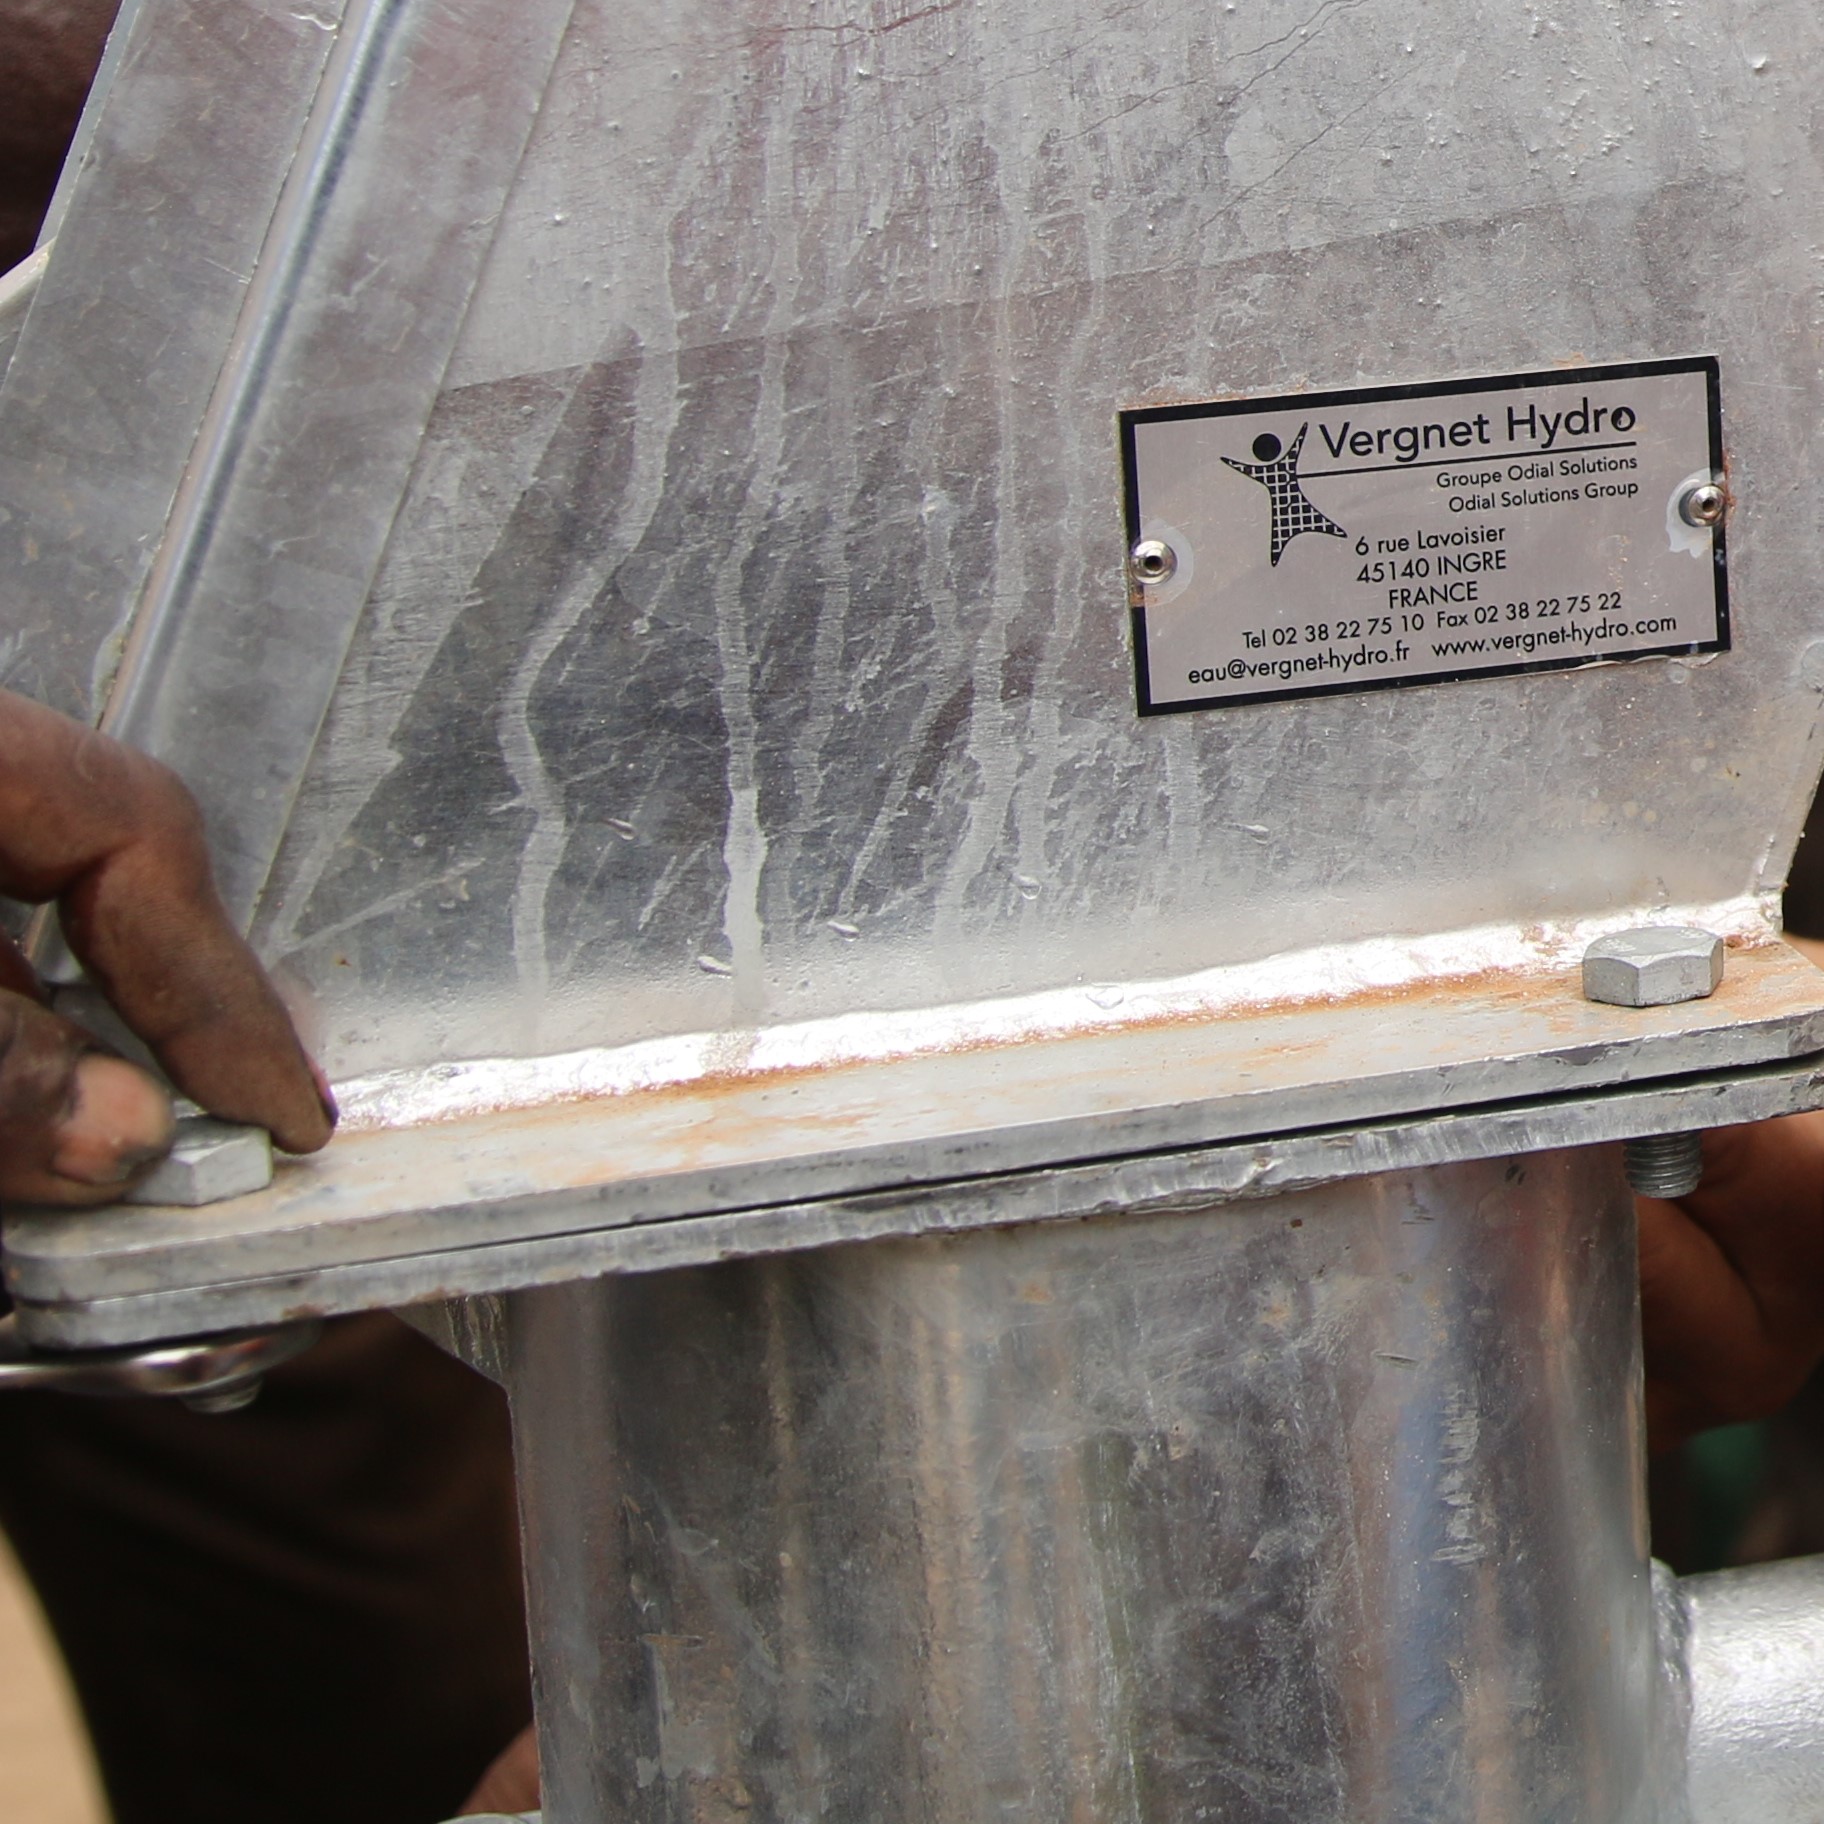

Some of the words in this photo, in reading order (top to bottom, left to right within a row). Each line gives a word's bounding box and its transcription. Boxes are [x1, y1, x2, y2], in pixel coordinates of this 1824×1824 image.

[1318, 413, 1491, 463] Vergnet
[1506, 396, 1637, 450] Hydro
[1436, 471, 1503, 489] Groupe
[1507, 460, 1554, 482] Odial
[1559, 457, 1638, 477] Solutions
[1448, 492, 1496, 513] Odial
[1500, 488, 1580, 508] Solutions
[1584, 482, 1639, 499] Group
[1355, 535, 1370, 557] 6
[1377, 537, 1410, 554] rue
[1417, 527, 1506, 550] Lavoisier
[1355, 557, 1430, 584] 45140
[1437, 549, 1507, 577] INGRE
[1388, 580, 1479, 610] FRANCE
[1241, 628, 1267, 649] Tel
[1272, 626, 1298, 647] 02
[1304, 623, 1330, 643] 38
[1335, 619, 1361, 640] 22
[1367, 616, 1393, 636] 75
[1401, 613, 1425, 633] 10
[1436, 610, 1469, 629] Fax
[1474, 605, 1499, 625] 02
[1505, 601, 1530, 622] 38
[1536, 598, 1561, 618] 22
[1566, 594, 1591, 614] 75
[1597, 591, 1622, 611] 22
[1187, 639, 1411, 684] eau@vergnet-hydro.fr
[1430, 616, 1677, 657] www.vergnet-hydro.com
